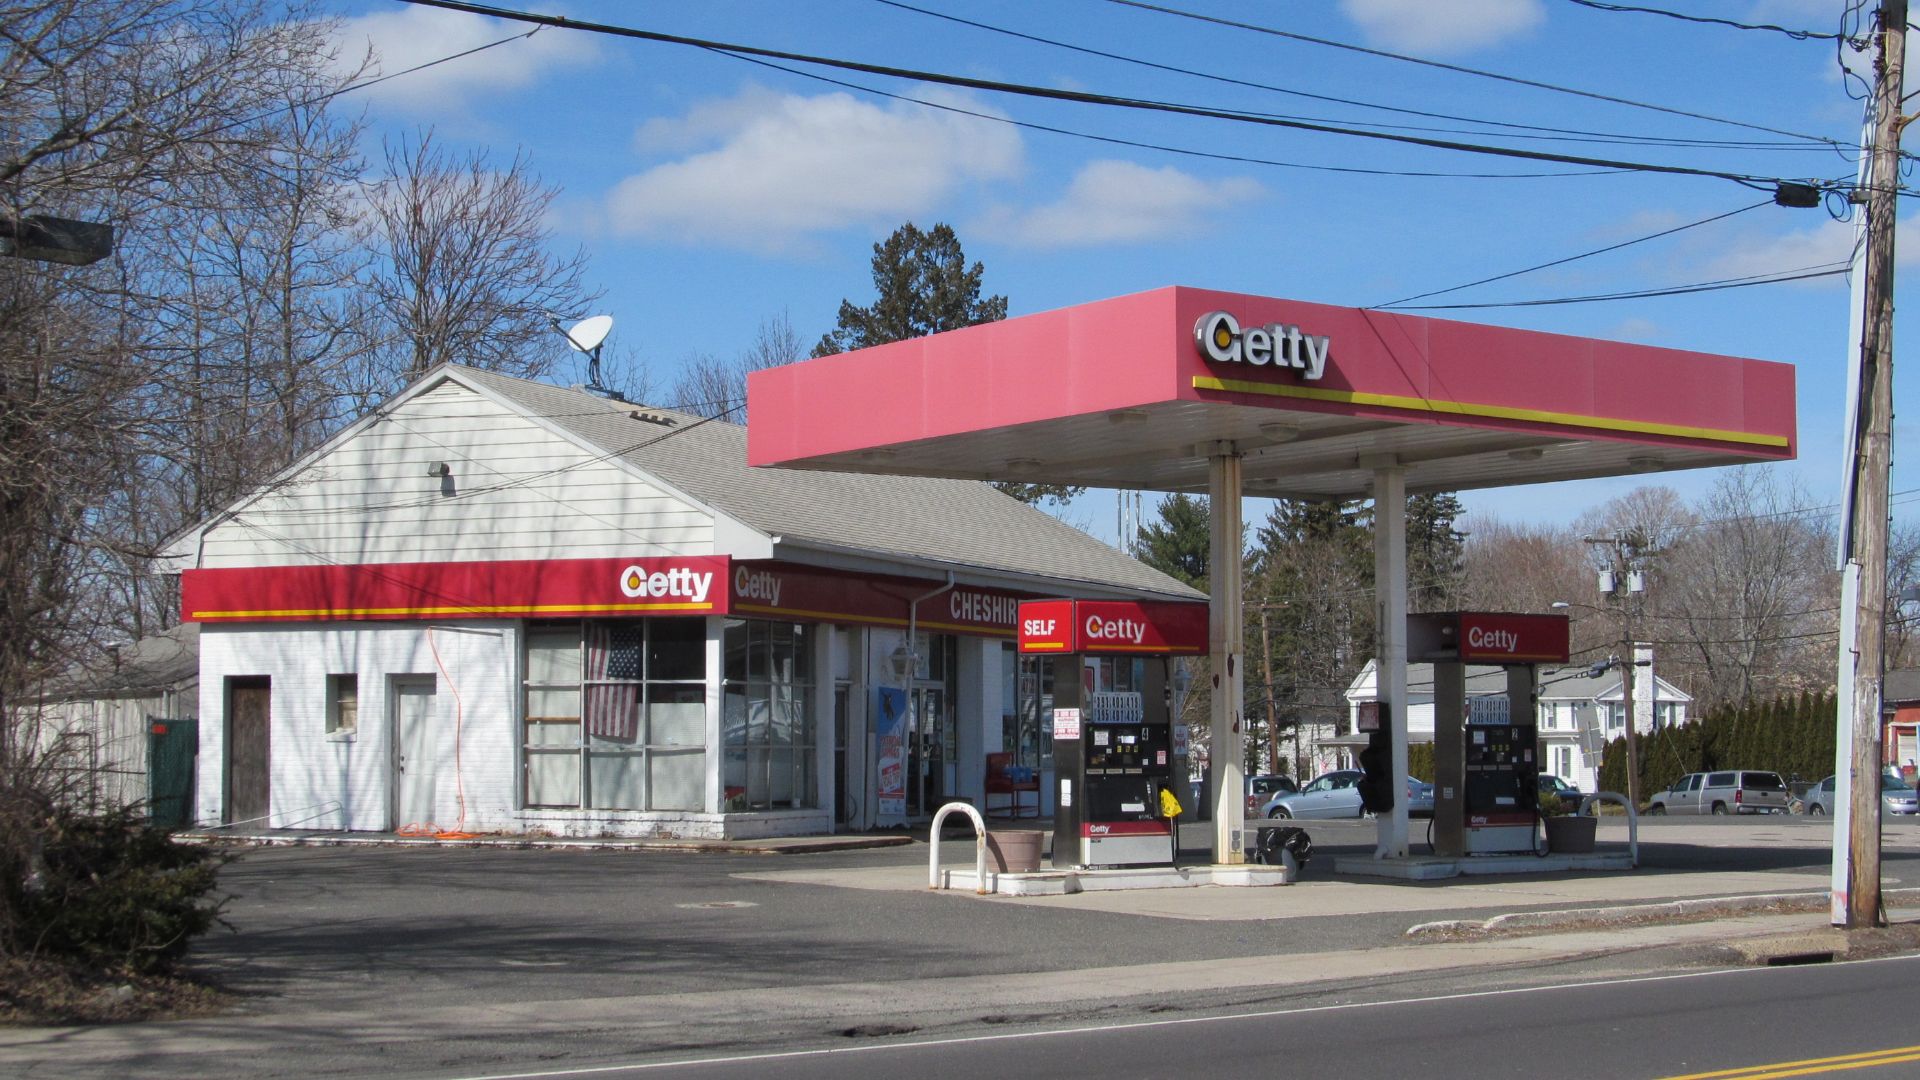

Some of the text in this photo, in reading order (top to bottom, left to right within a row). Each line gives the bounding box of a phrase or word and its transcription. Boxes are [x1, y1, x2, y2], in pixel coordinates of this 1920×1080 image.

[1194, 310, 1330, 380] Getty
[620, 565, 713, 603] Getty
[735, 565, 782, 606] Getty
[1024, 619, 1056, 636] SELF
[1085, 615, 1145, 644] Getty
[1468, 626, 1518, 653] Getty
[1089, 824, 1110, 834] Getty
